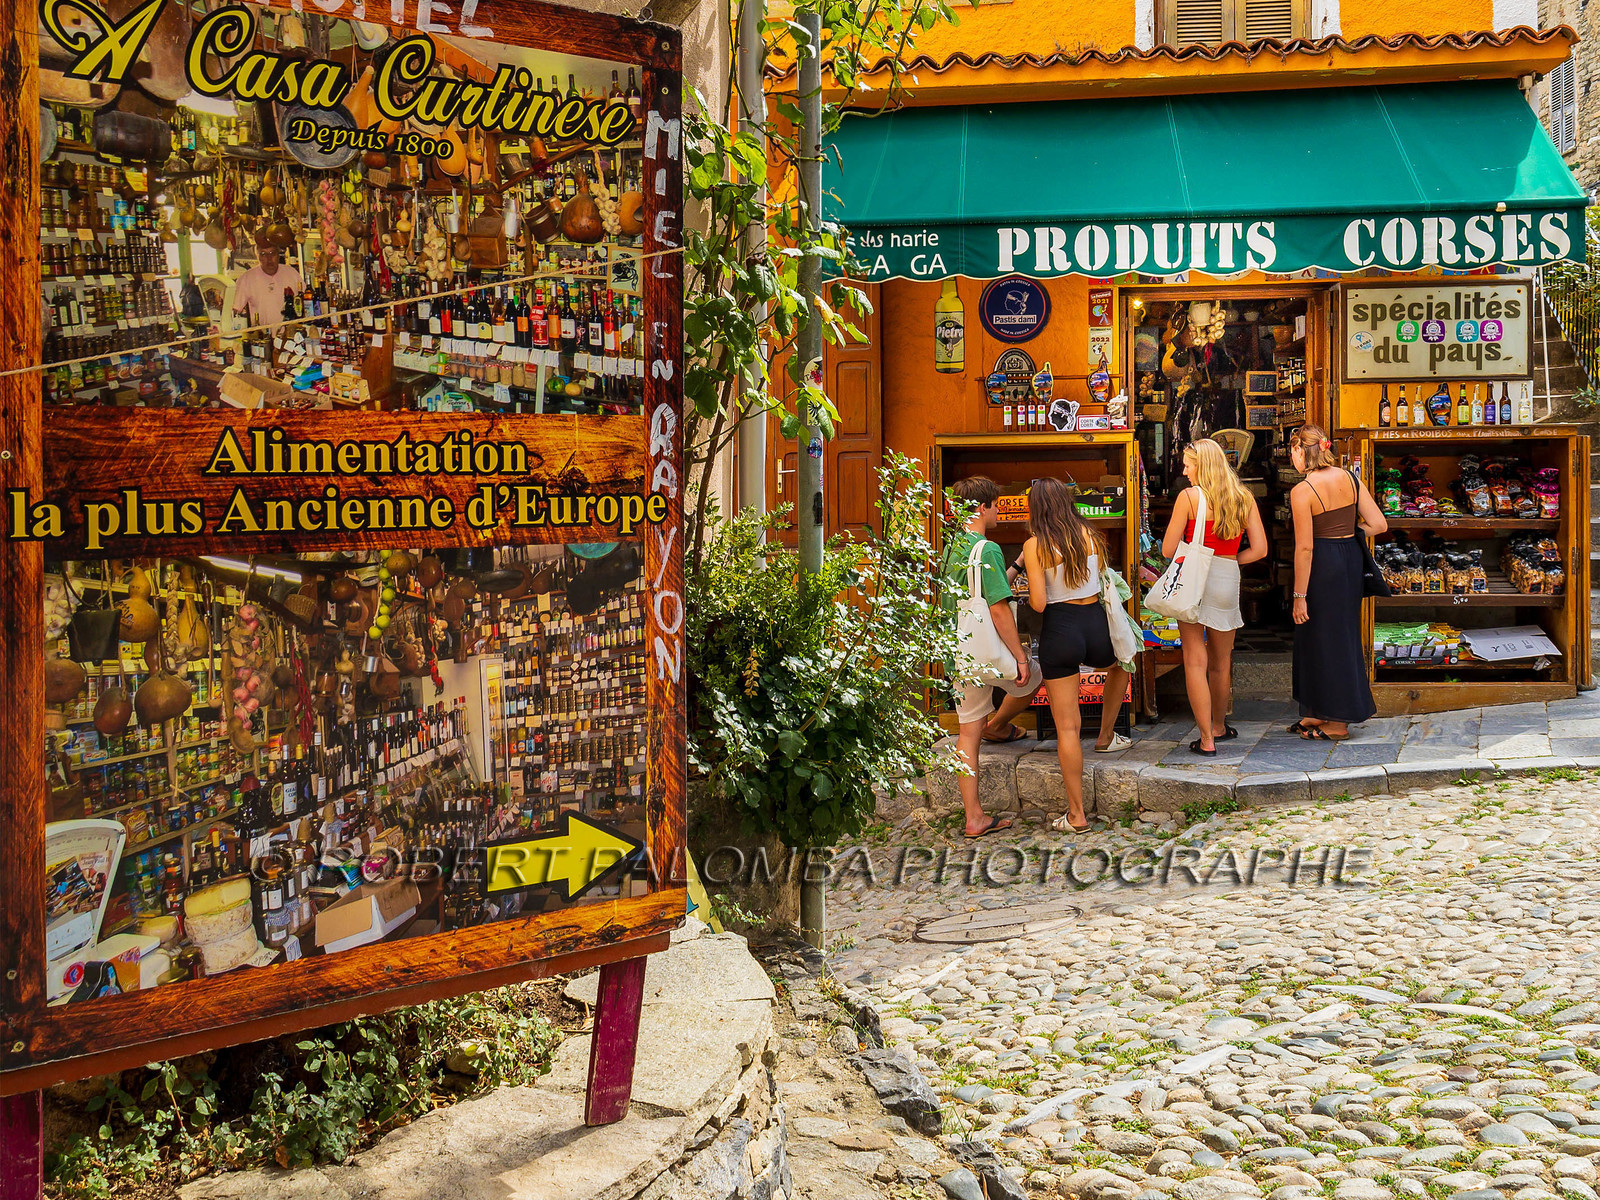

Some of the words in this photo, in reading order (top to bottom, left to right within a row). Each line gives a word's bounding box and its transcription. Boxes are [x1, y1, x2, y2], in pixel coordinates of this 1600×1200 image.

[185, 3, 347, 108] Casa
[374, 35, 635, 146] Curtinese
[291, 120, 386, 152] Depuis
[394, 136, 454, 158] 1800
[644, 109, 681, 279] MIEL
[997, 221, 1277, 271] PRODUITS
[1343, 212, 1571, 266] CORSES
[1018, 315, 1036, 323] dami
[1352, 292, 1521, 331] spécialités
[936, 326, 963, 339] Pietra
[1373, 336, 1410, 364] du
[1429, 342, 1502, 372] pays
[205, 430, 528, 474] Alimentation
[1411, 429, 1453, 438] ROOIBOS
[9, 490, 65, 538] la
[83, 489, 203, 550] plus
[216, 487, 452, 532] Ancienne
[467, 486, 667, 535] d’Europe
[995, 498, 1024, 508] ORSE
[1077, 505, 1113, 517] RUIT
